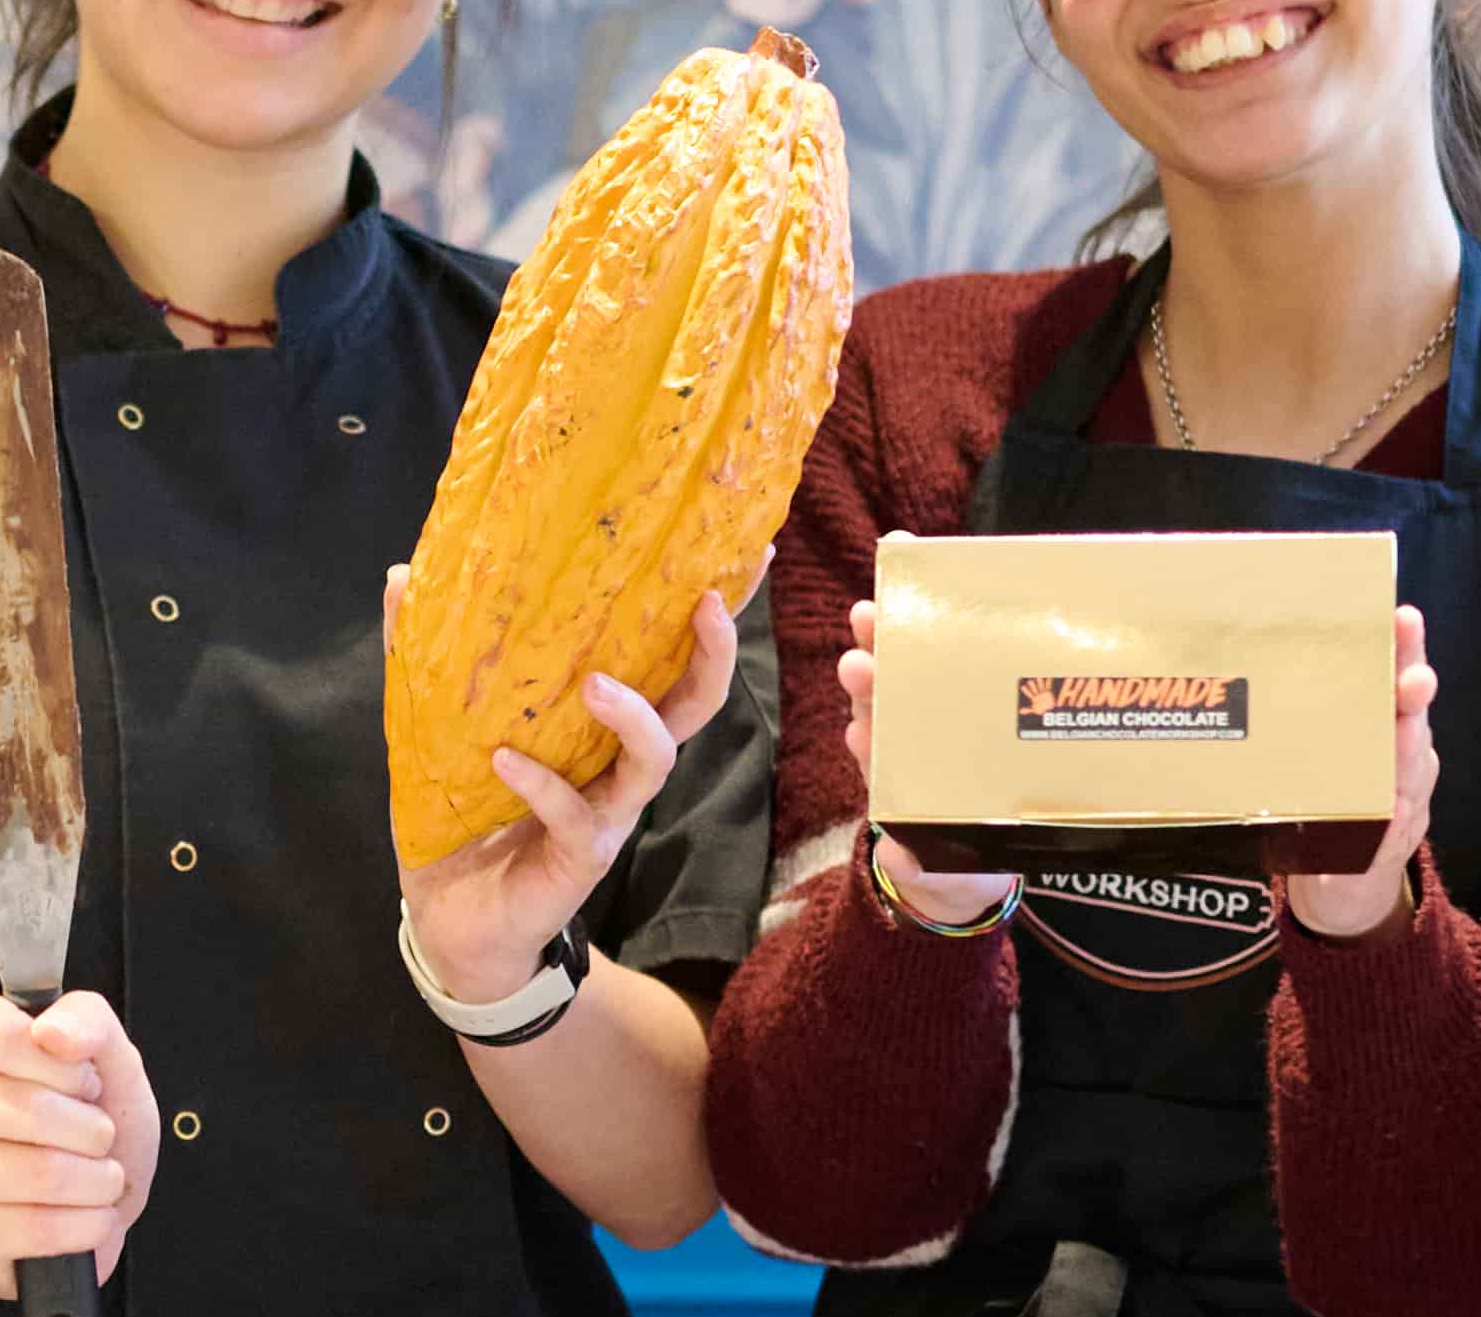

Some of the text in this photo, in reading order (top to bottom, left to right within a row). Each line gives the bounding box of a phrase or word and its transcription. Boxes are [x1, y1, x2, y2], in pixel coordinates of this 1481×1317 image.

[1056, 677, 1235, 708] HANDMADE
[1043, 712, 1230, 727] BELGIAN CHOCOLATE
